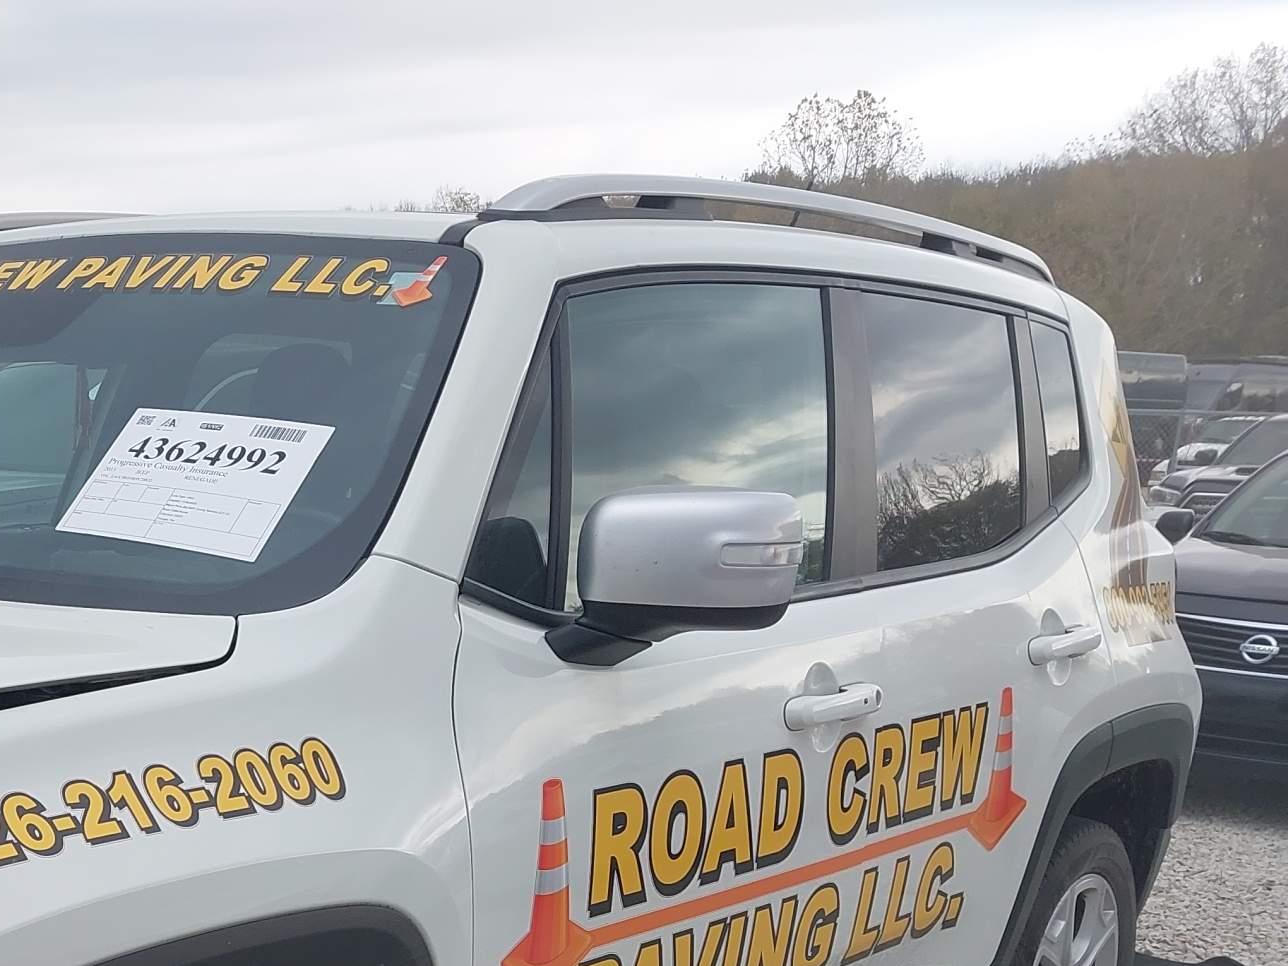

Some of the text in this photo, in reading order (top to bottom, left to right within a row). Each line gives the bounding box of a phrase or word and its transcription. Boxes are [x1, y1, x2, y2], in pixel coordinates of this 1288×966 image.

[57, 253, 270, 296] PAVING
[270, 253, 394, 299] LLC.
[128, 436, 287, 475] 43624992
[154, 462, 186, 473] Casualty
[189, 467, 229, 478] Insurance
[587, 702, 990, 917] ROAD CREW
[840, 842, 965, 966] LLC.
